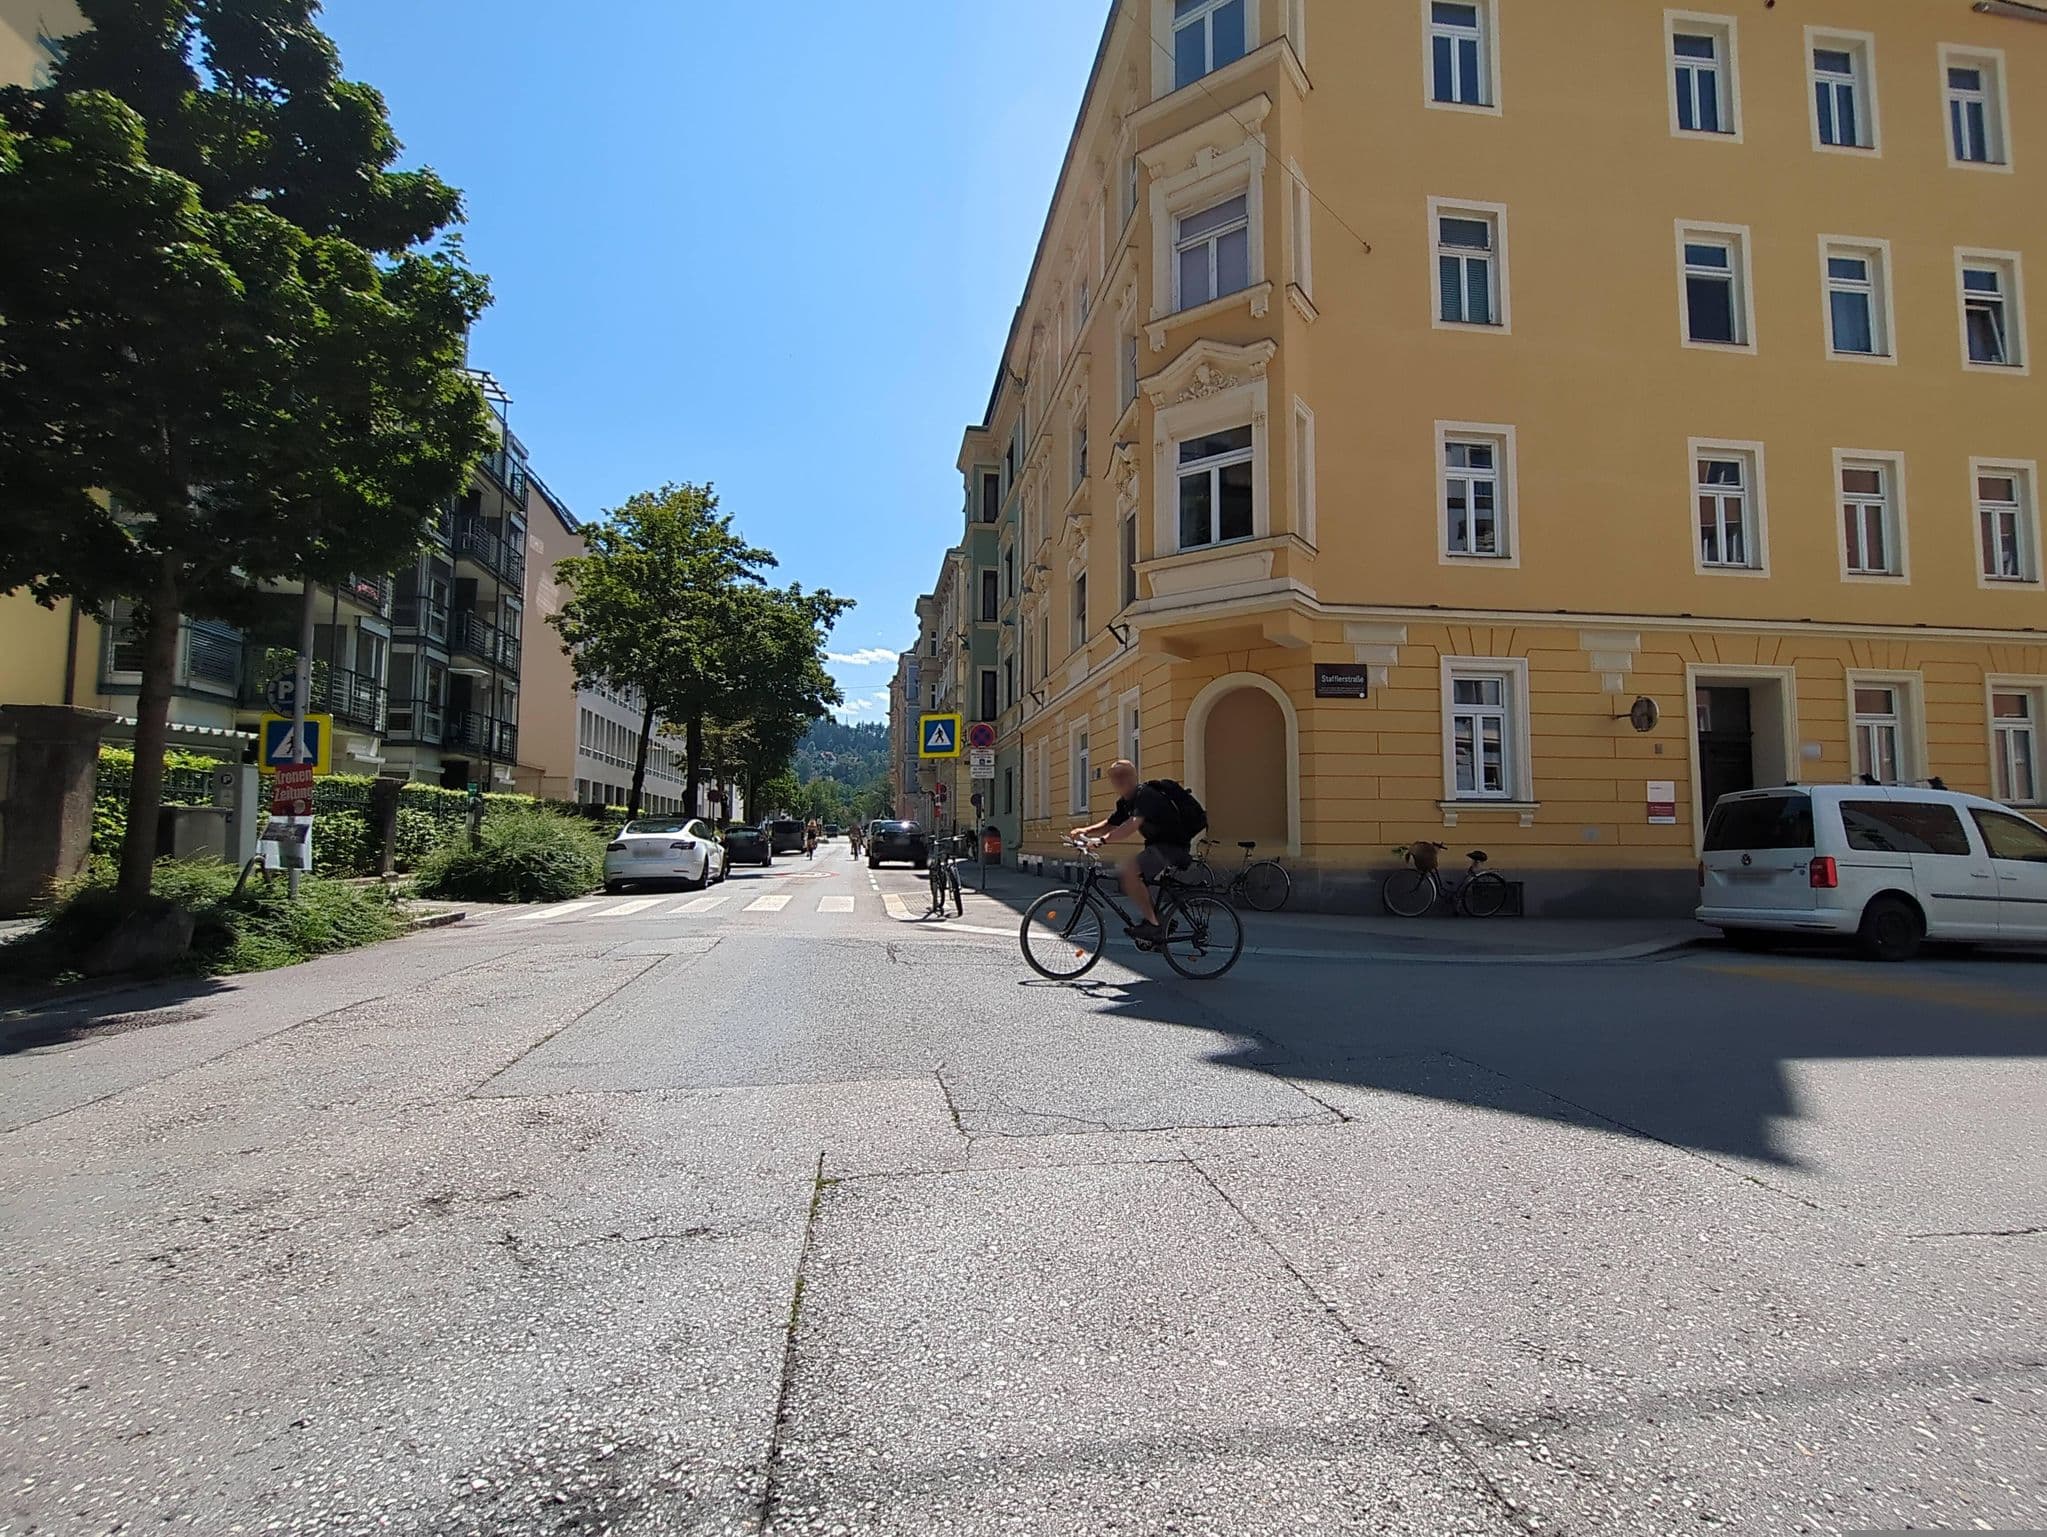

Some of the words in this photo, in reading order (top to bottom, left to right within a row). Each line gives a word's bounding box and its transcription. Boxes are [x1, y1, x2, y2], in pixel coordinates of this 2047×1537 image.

[278, 681, 295, 699] P
[276, 769, 313, 785] Kronen
[274, 785, 314, 802] Zeitung
